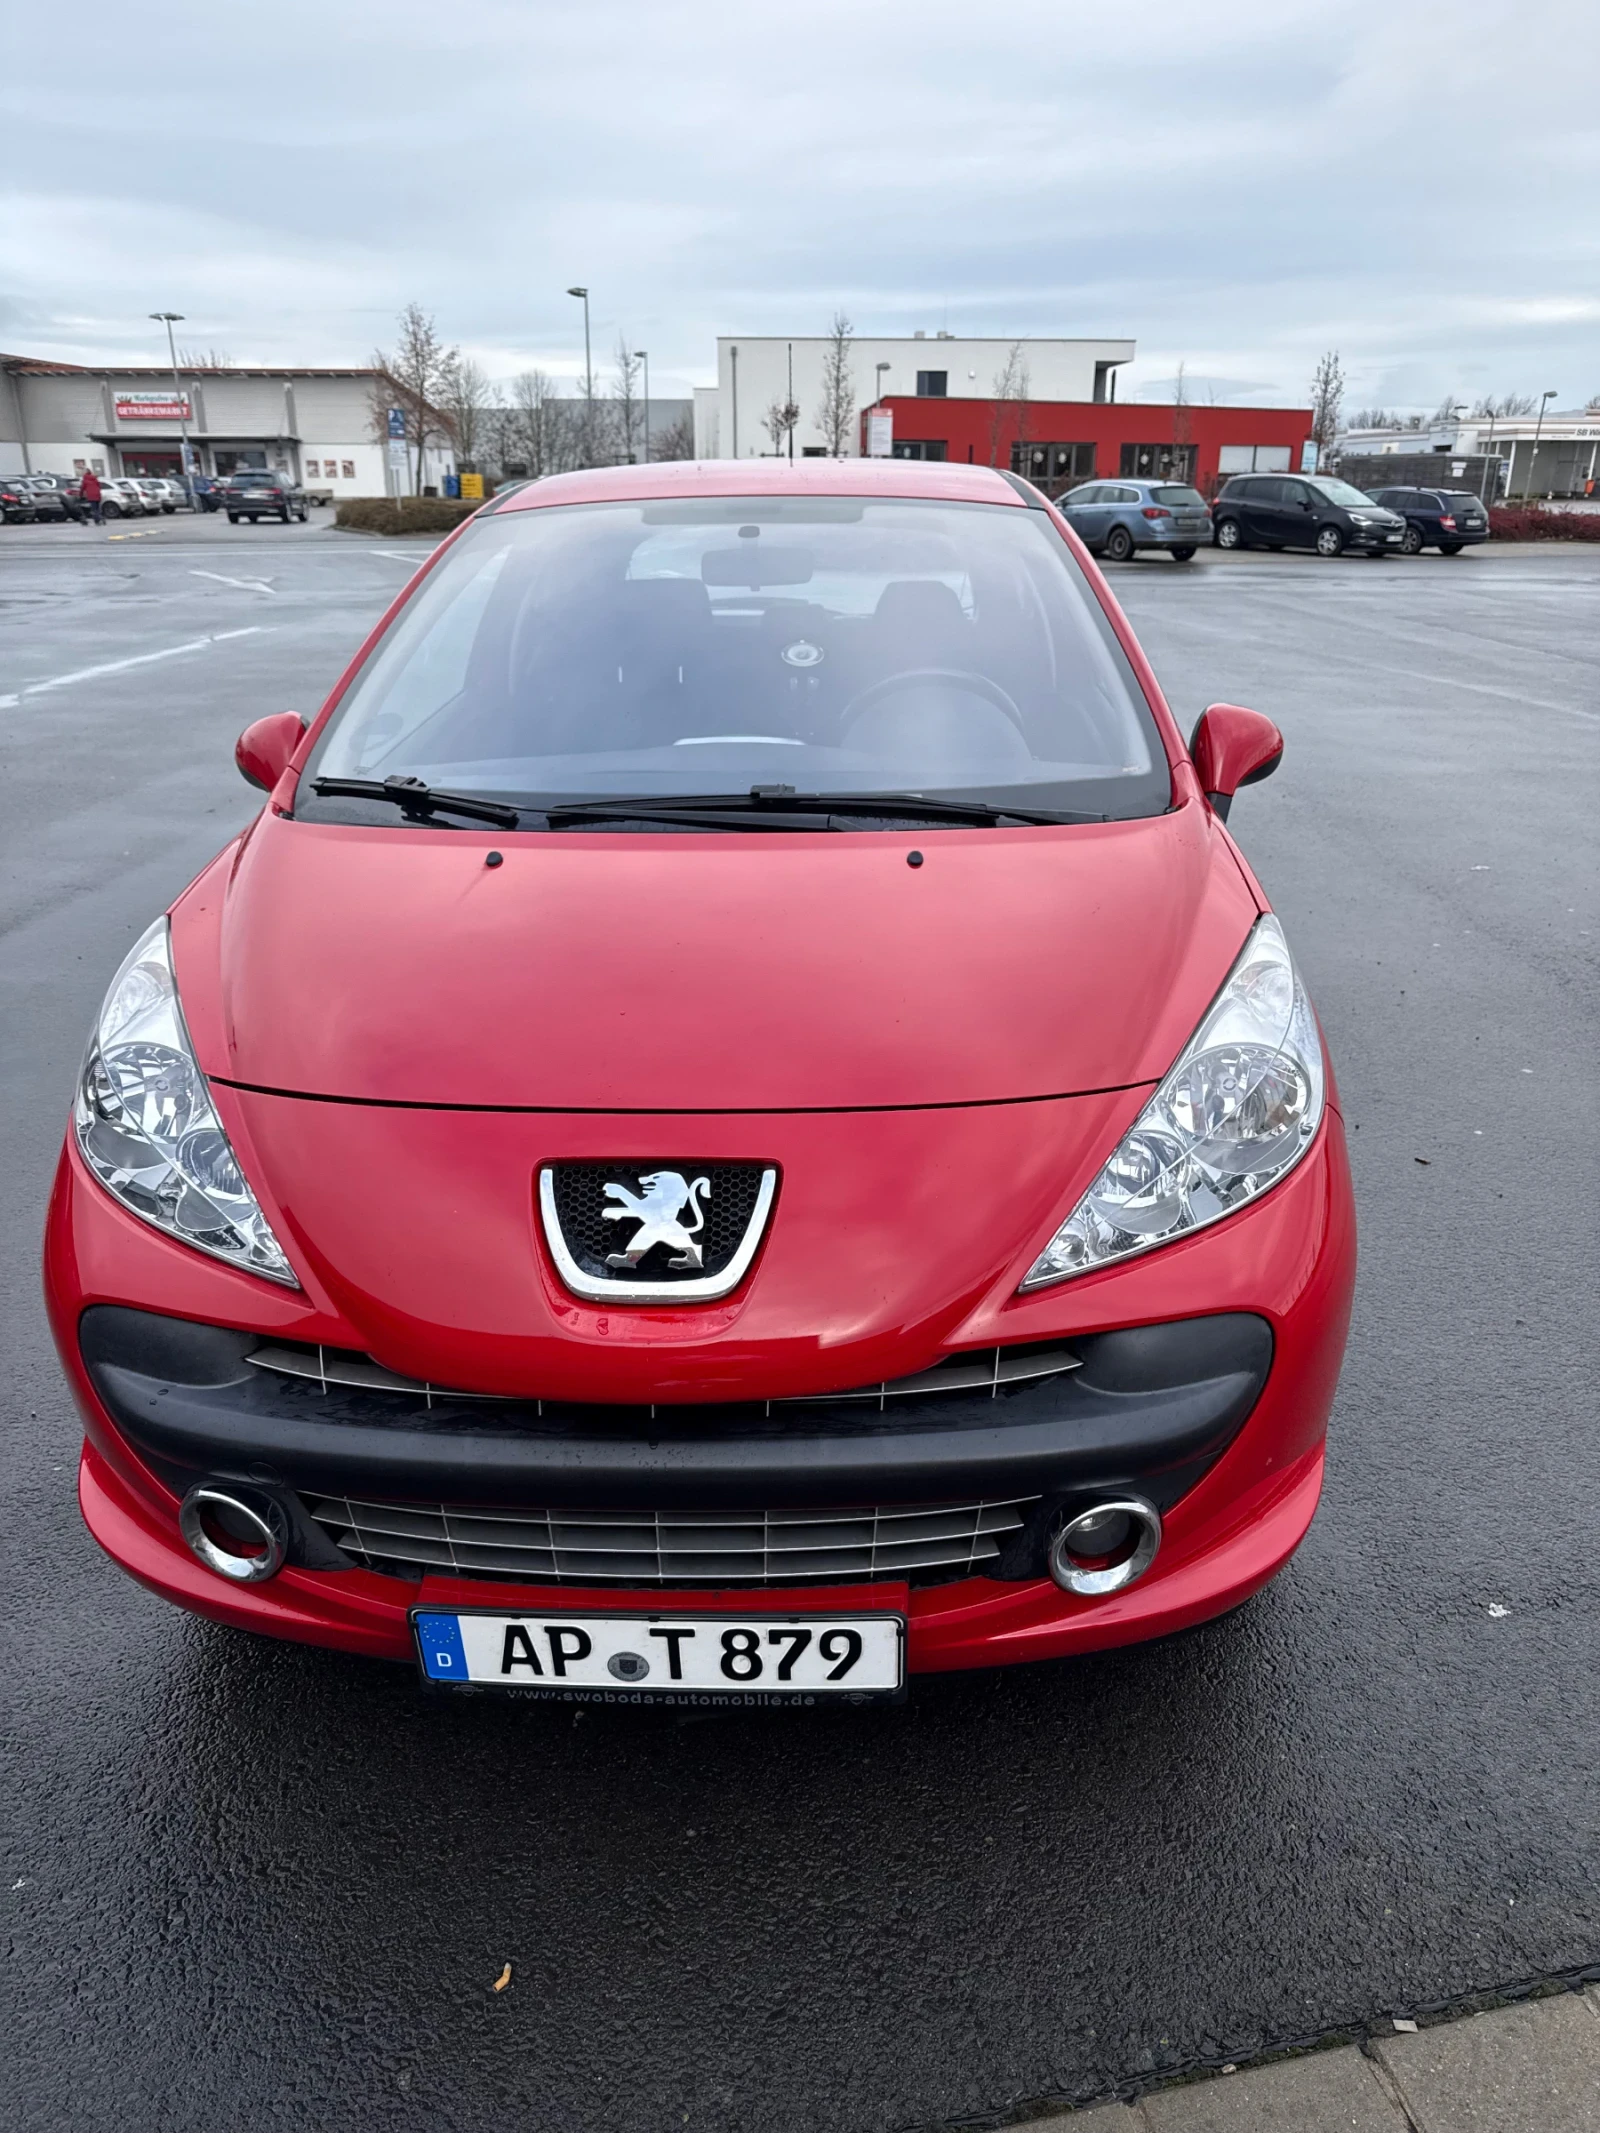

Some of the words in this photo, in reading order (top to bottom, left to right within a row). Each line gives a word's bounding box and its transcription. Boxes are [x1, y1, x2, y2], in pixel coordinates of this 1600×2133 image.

[436, 1652, 452, 1668] D
[500, 1625, 592, 1676] AP
[649, 1628, 695, 1680] T
[720, 1628, 863, 1681] 879
[506, 1689, 816, 1706] www.swoboda-automobile.de
